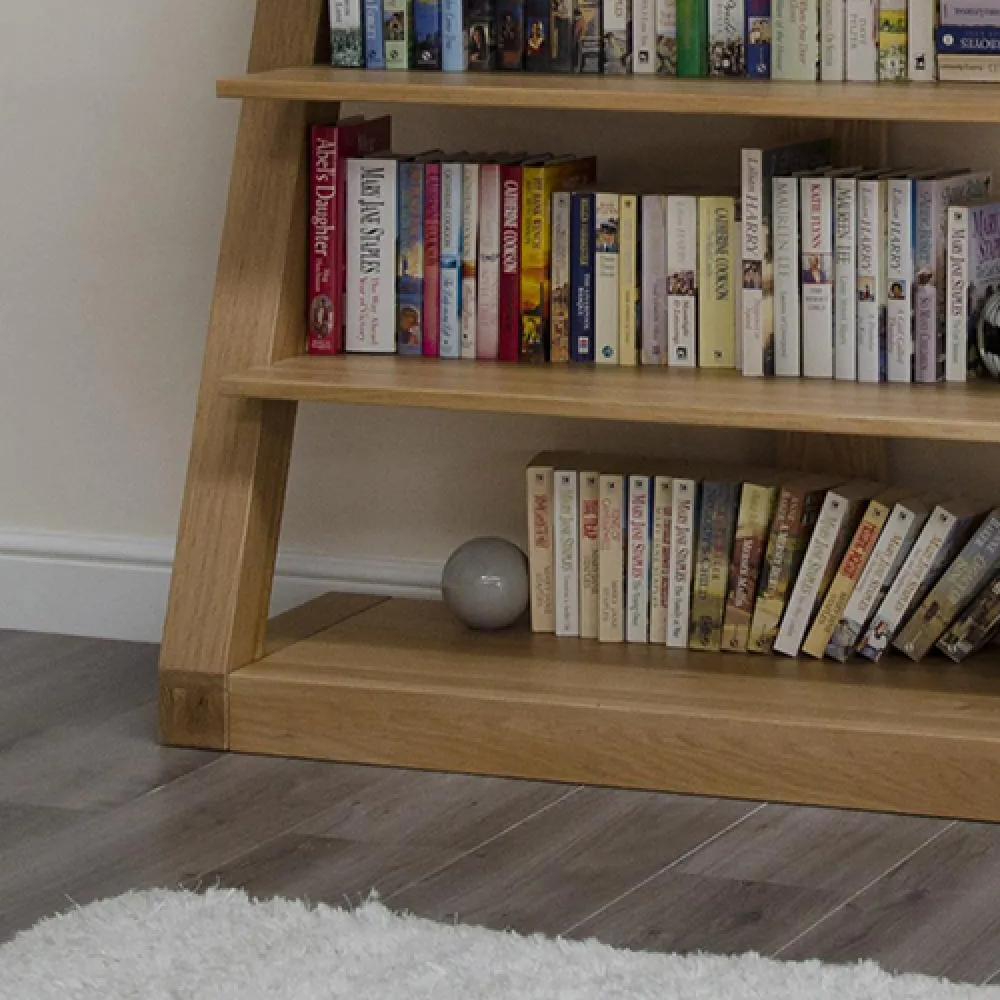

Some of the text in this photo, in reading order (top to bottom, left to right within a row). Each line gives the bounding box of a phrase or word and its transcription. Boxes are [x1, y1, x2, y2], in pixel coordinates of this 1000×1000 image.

[311, 138, 336, 257] Abel's Daughter
[358, 166, 385, 274] MARY JANE STAPLES
[503, 180, 518, 228] CATHERINE
[745, 195, 758, 257] HARRY
[776, 183, 791, 279] MAUREEN LEE
[810, 183, 822, 249] KATIE FLYNN
[837, 185, 851, 265] MAUREEN LEE
[972, 210, 998, 238] MARY
[503, 230, 518, 273] COOKSON
[715, 208, 728, 301] CATHERINE COOKSON
[860, 220, 873, 273] HARRY
[890, 220, 901, 273] HARRY
[950, 228, 965, 317] MARY JANE STAPLES
[630, 493, 646, 579] MARY JANE STAPLES
[676, 499, 691, 583] MARY JANE STAPLES
